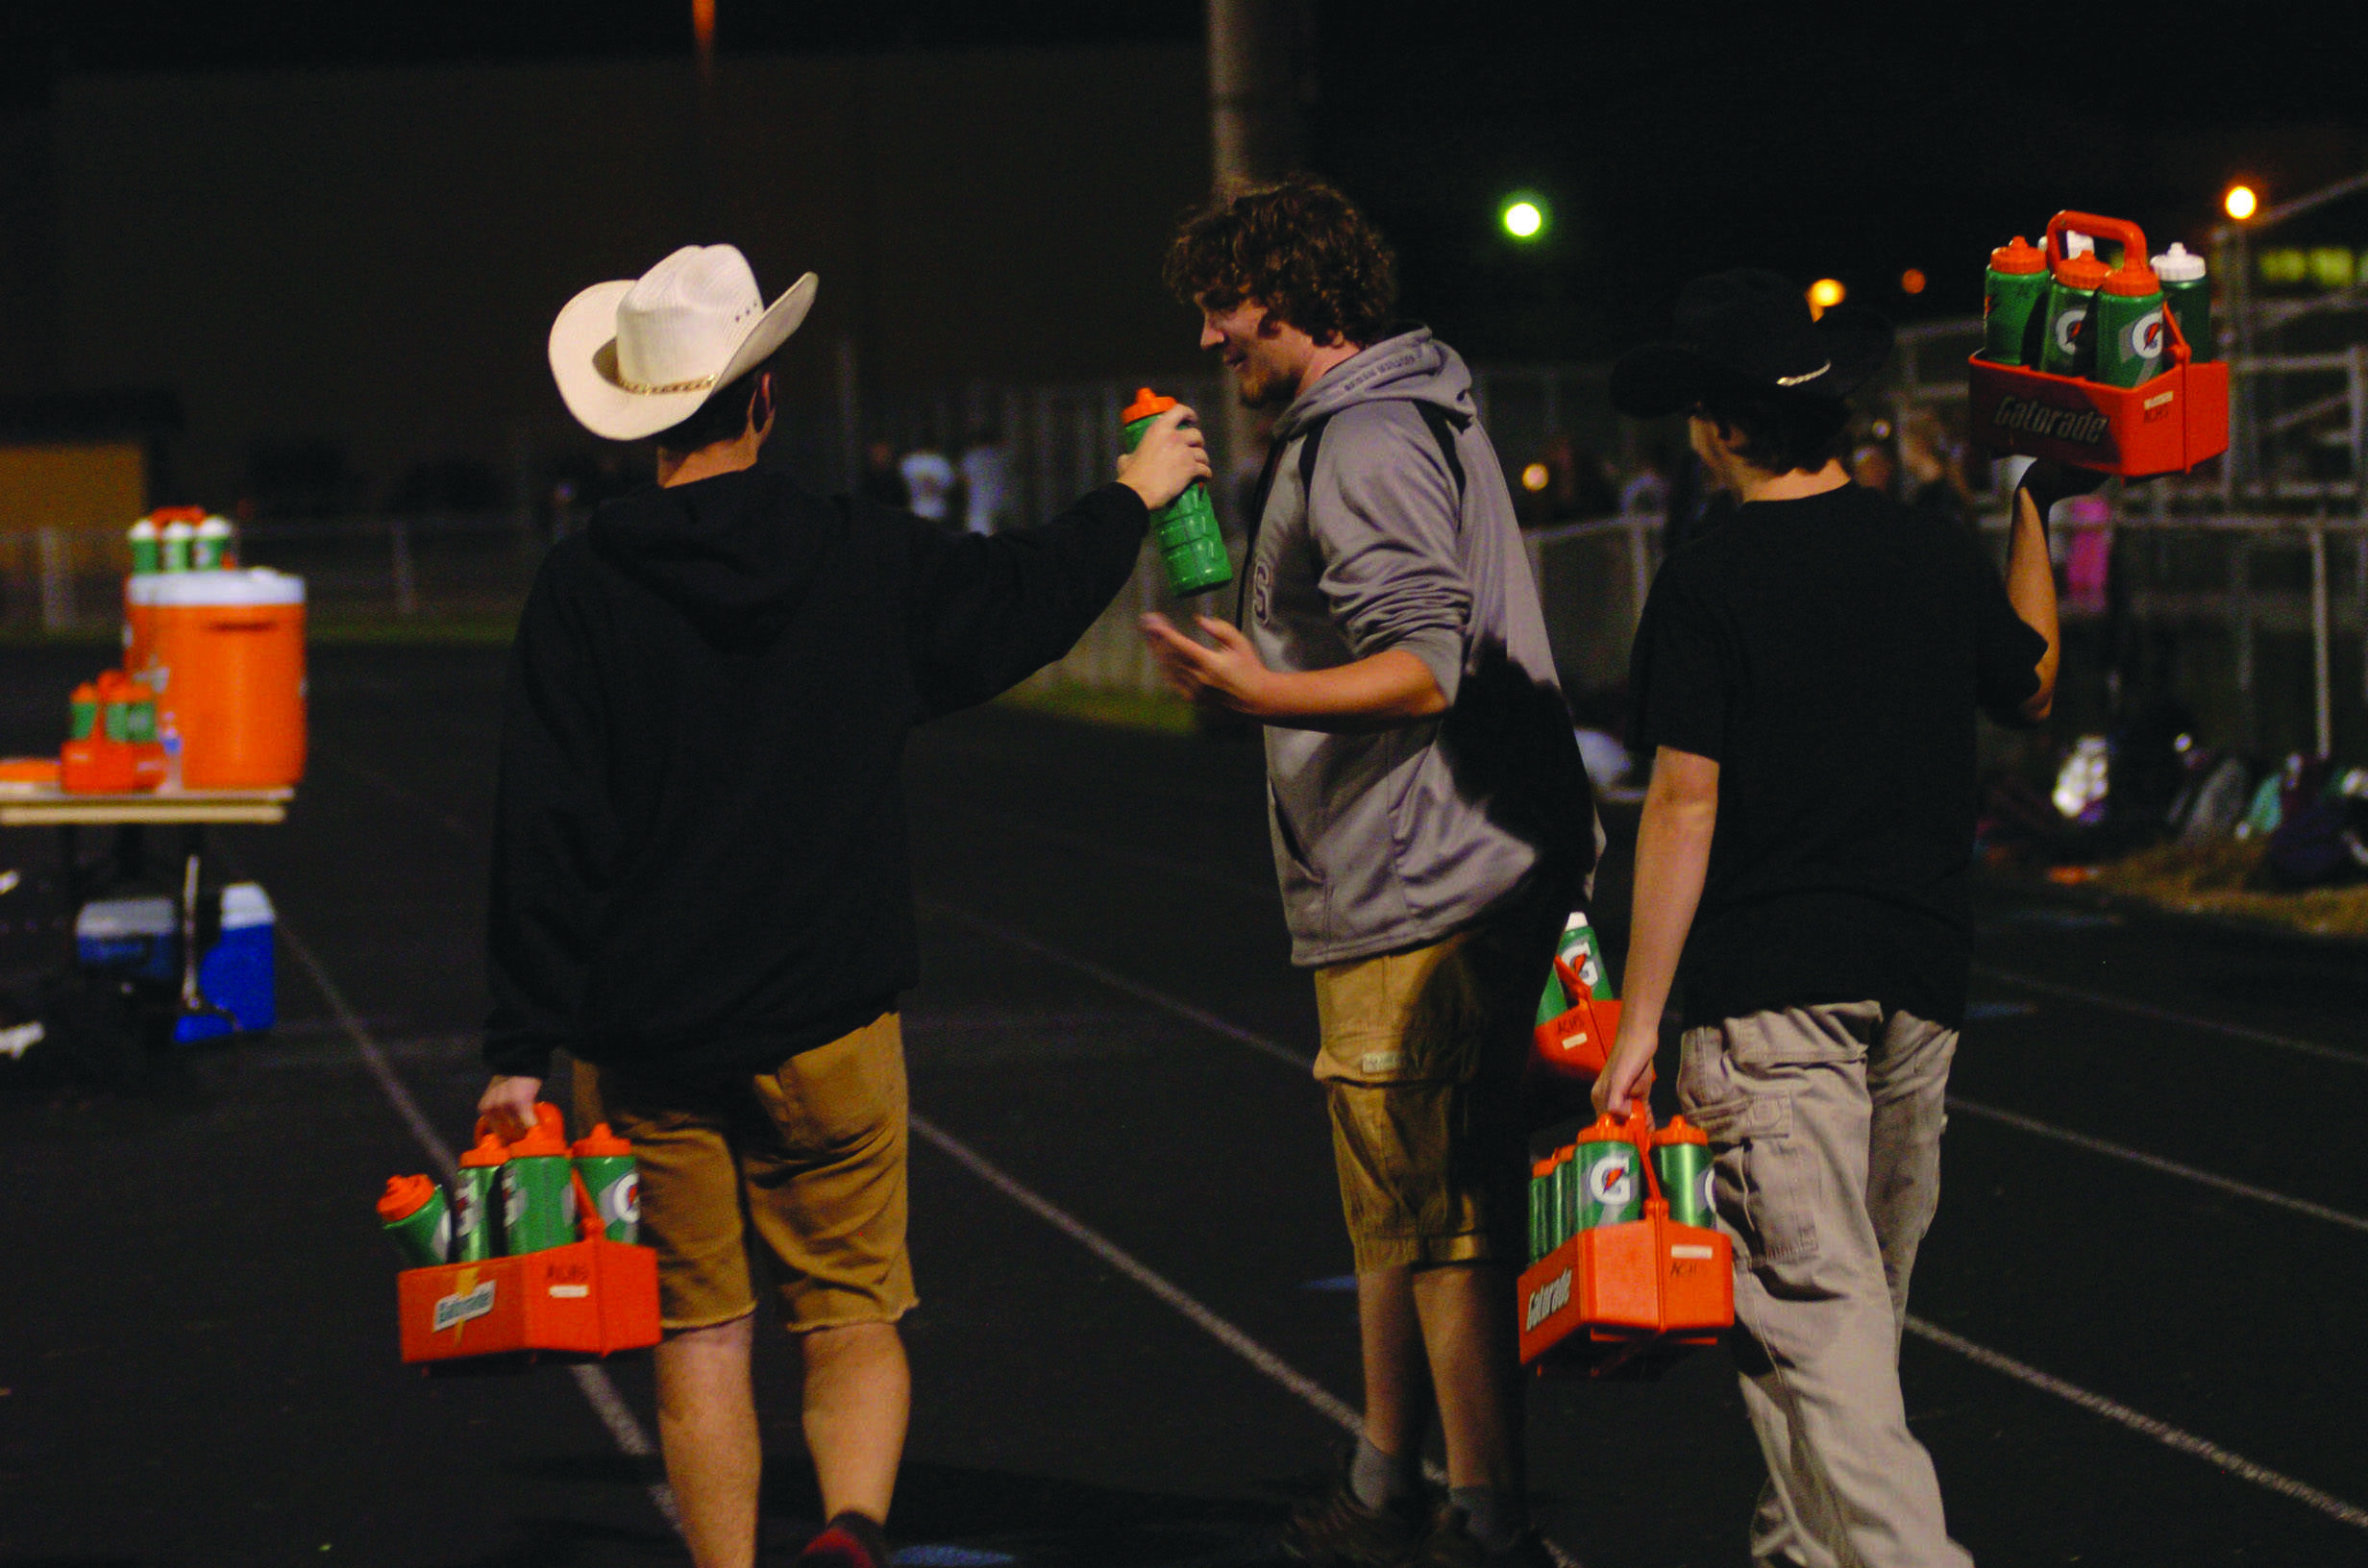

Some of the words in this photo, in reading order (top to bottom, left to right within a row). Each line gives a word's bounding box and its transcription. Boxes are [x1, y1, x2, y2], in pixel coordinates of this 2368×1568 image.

[2132, 310, 2164, 359] G
[1992, 395, 2109, 446] Gatorade
[1561, 942, 1598, 987] G
[1591, 1156, 1630, 1206] G
[1525, 1267, 1573, 1333] Gatorade
